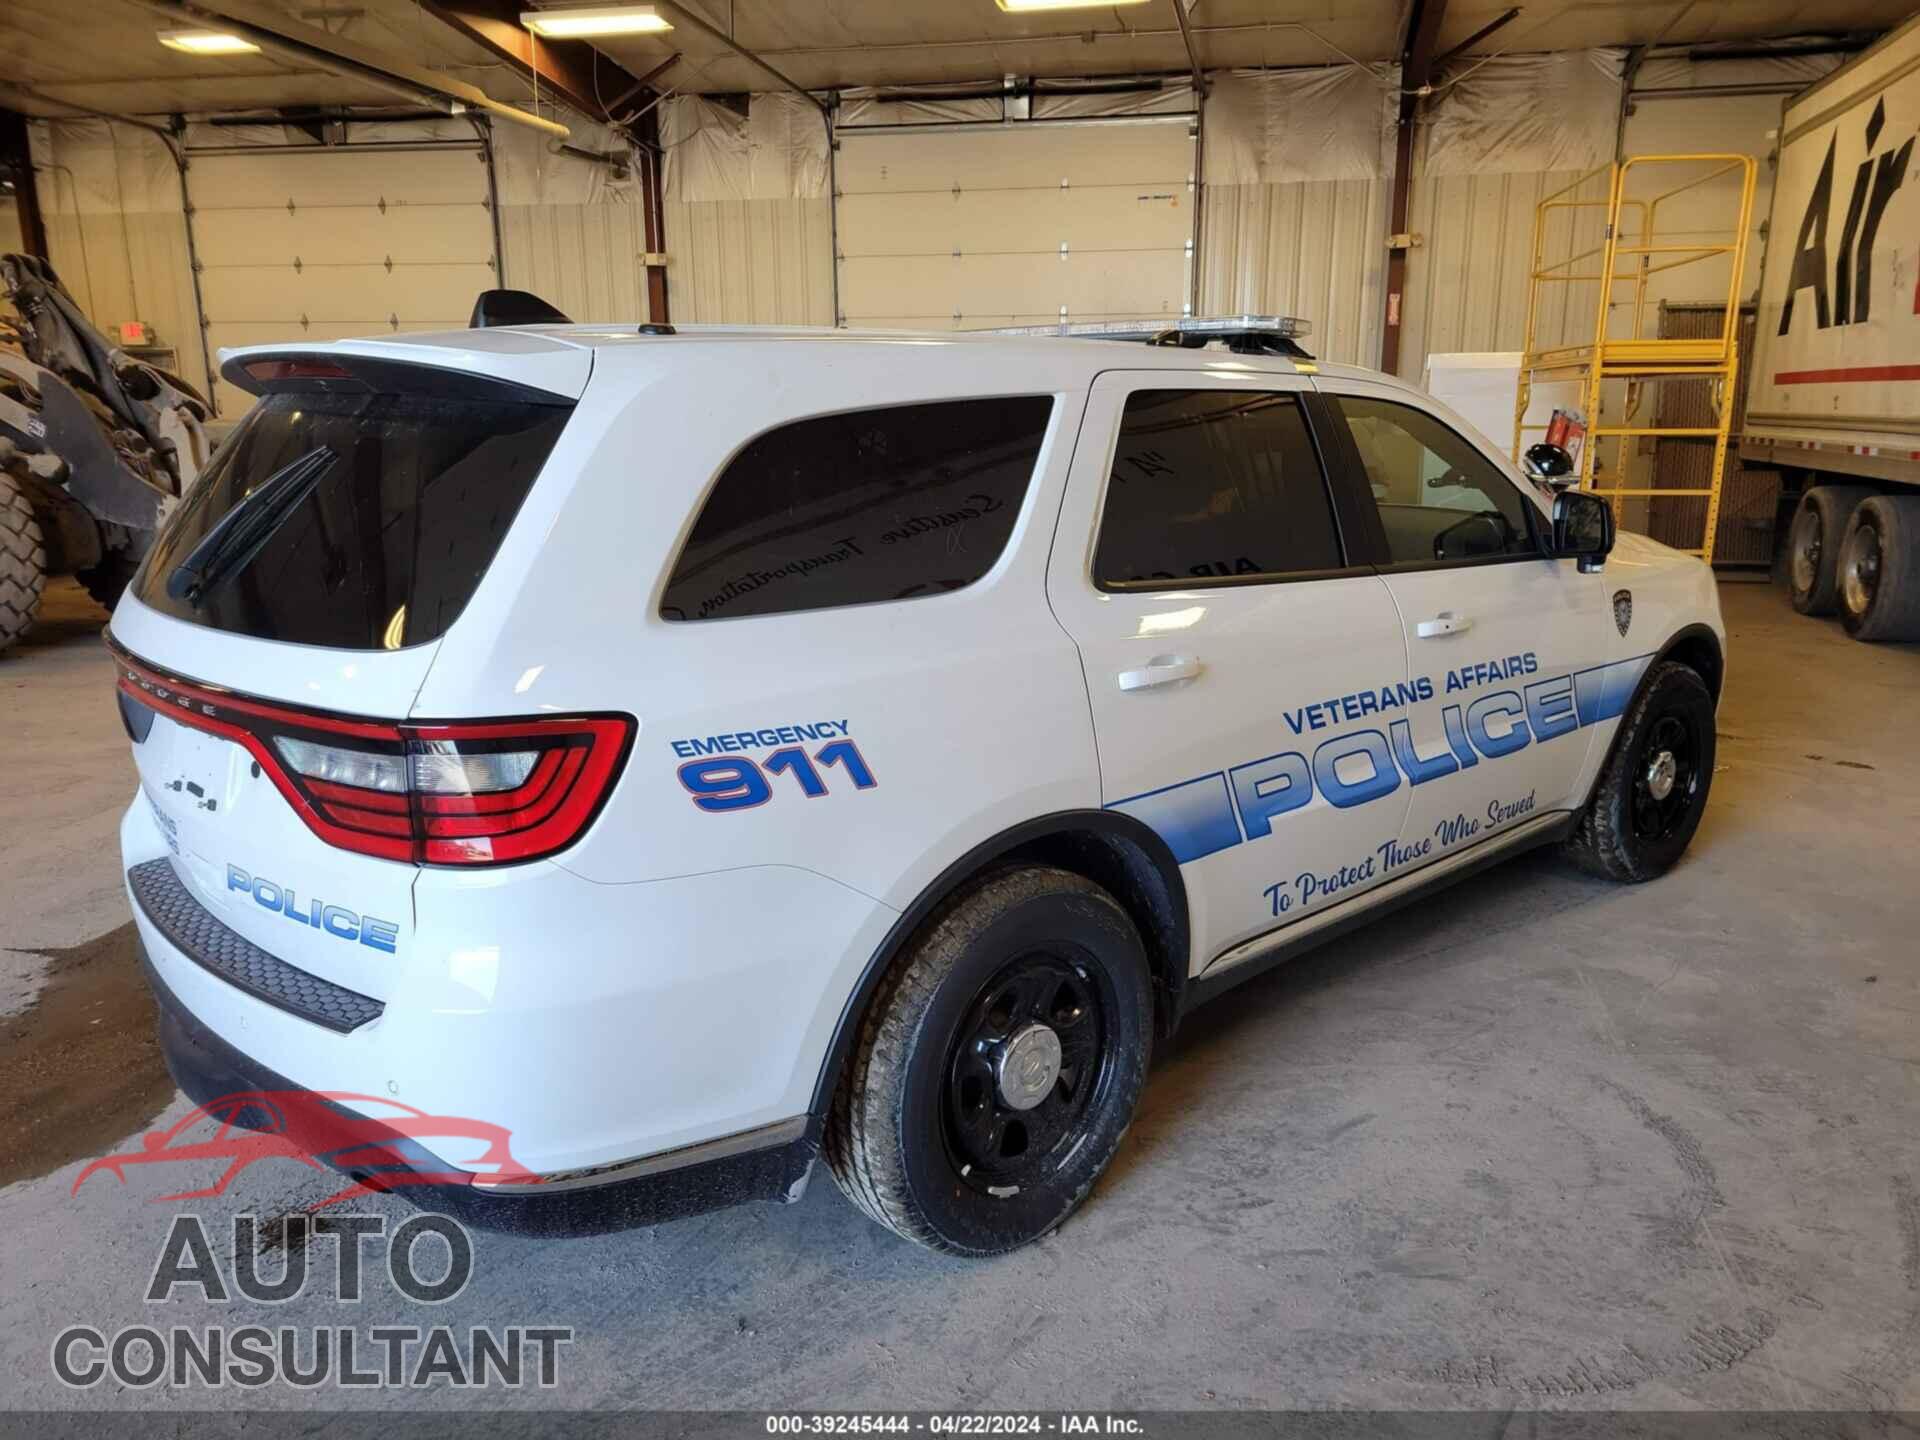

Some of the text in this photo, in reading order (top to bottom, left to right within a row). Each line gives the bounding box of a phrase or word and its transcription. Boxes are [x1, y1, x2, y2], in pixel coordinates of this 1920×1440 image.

[1777, 94, 1916, 336] Air
[671, 720, 849, 758] EMERGENCY
[1283, 652, 1538, 735] VETERANS AFFAIRS
[677, 738, 878, 814] 911
[1229, 673, 1579, 841] POLICE
[1263, 789, 1537, 917] To Protect Those Who Served
[226, 863, 400, 954] POLICE
